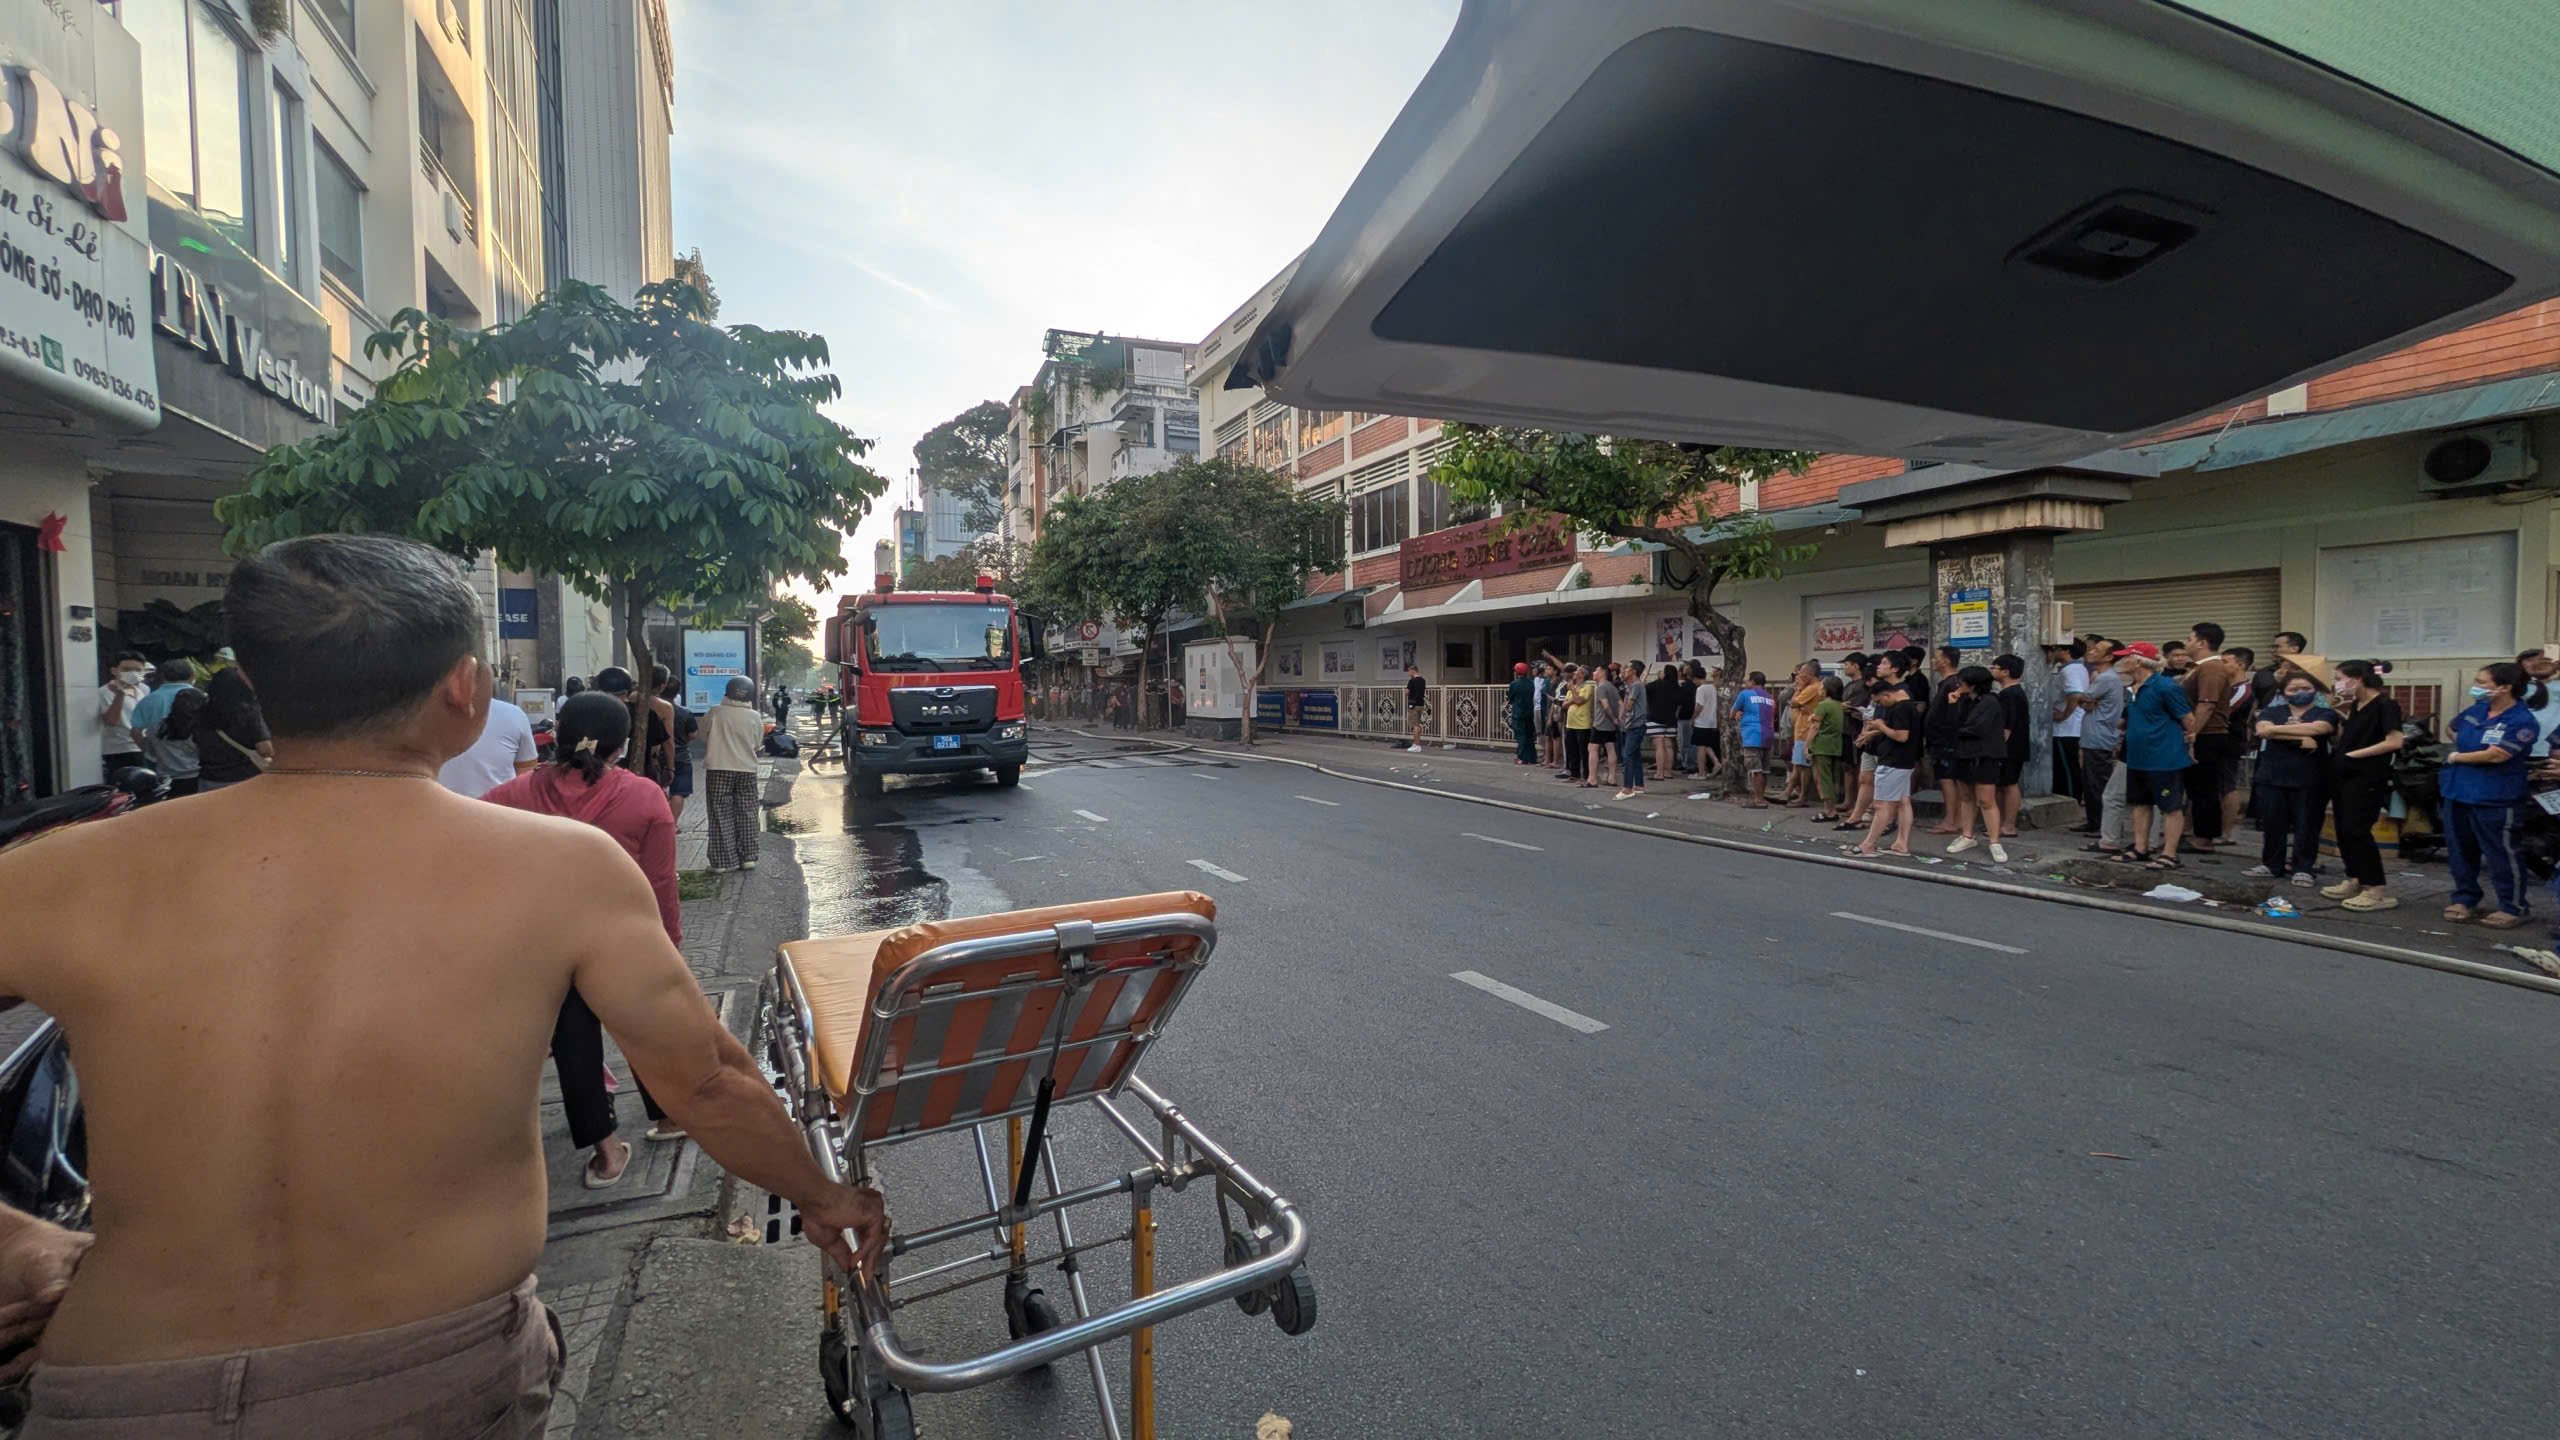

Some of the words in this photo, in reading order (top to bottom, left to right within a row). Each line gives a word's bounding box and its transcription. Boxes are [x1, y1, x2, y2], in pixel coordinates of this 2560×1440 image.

[73, 358, 109, 390] 0983
[110, 376, 132, 400] 136
[135, 388, 155, 411] 476
[921, 705, 968, 716] MAN
